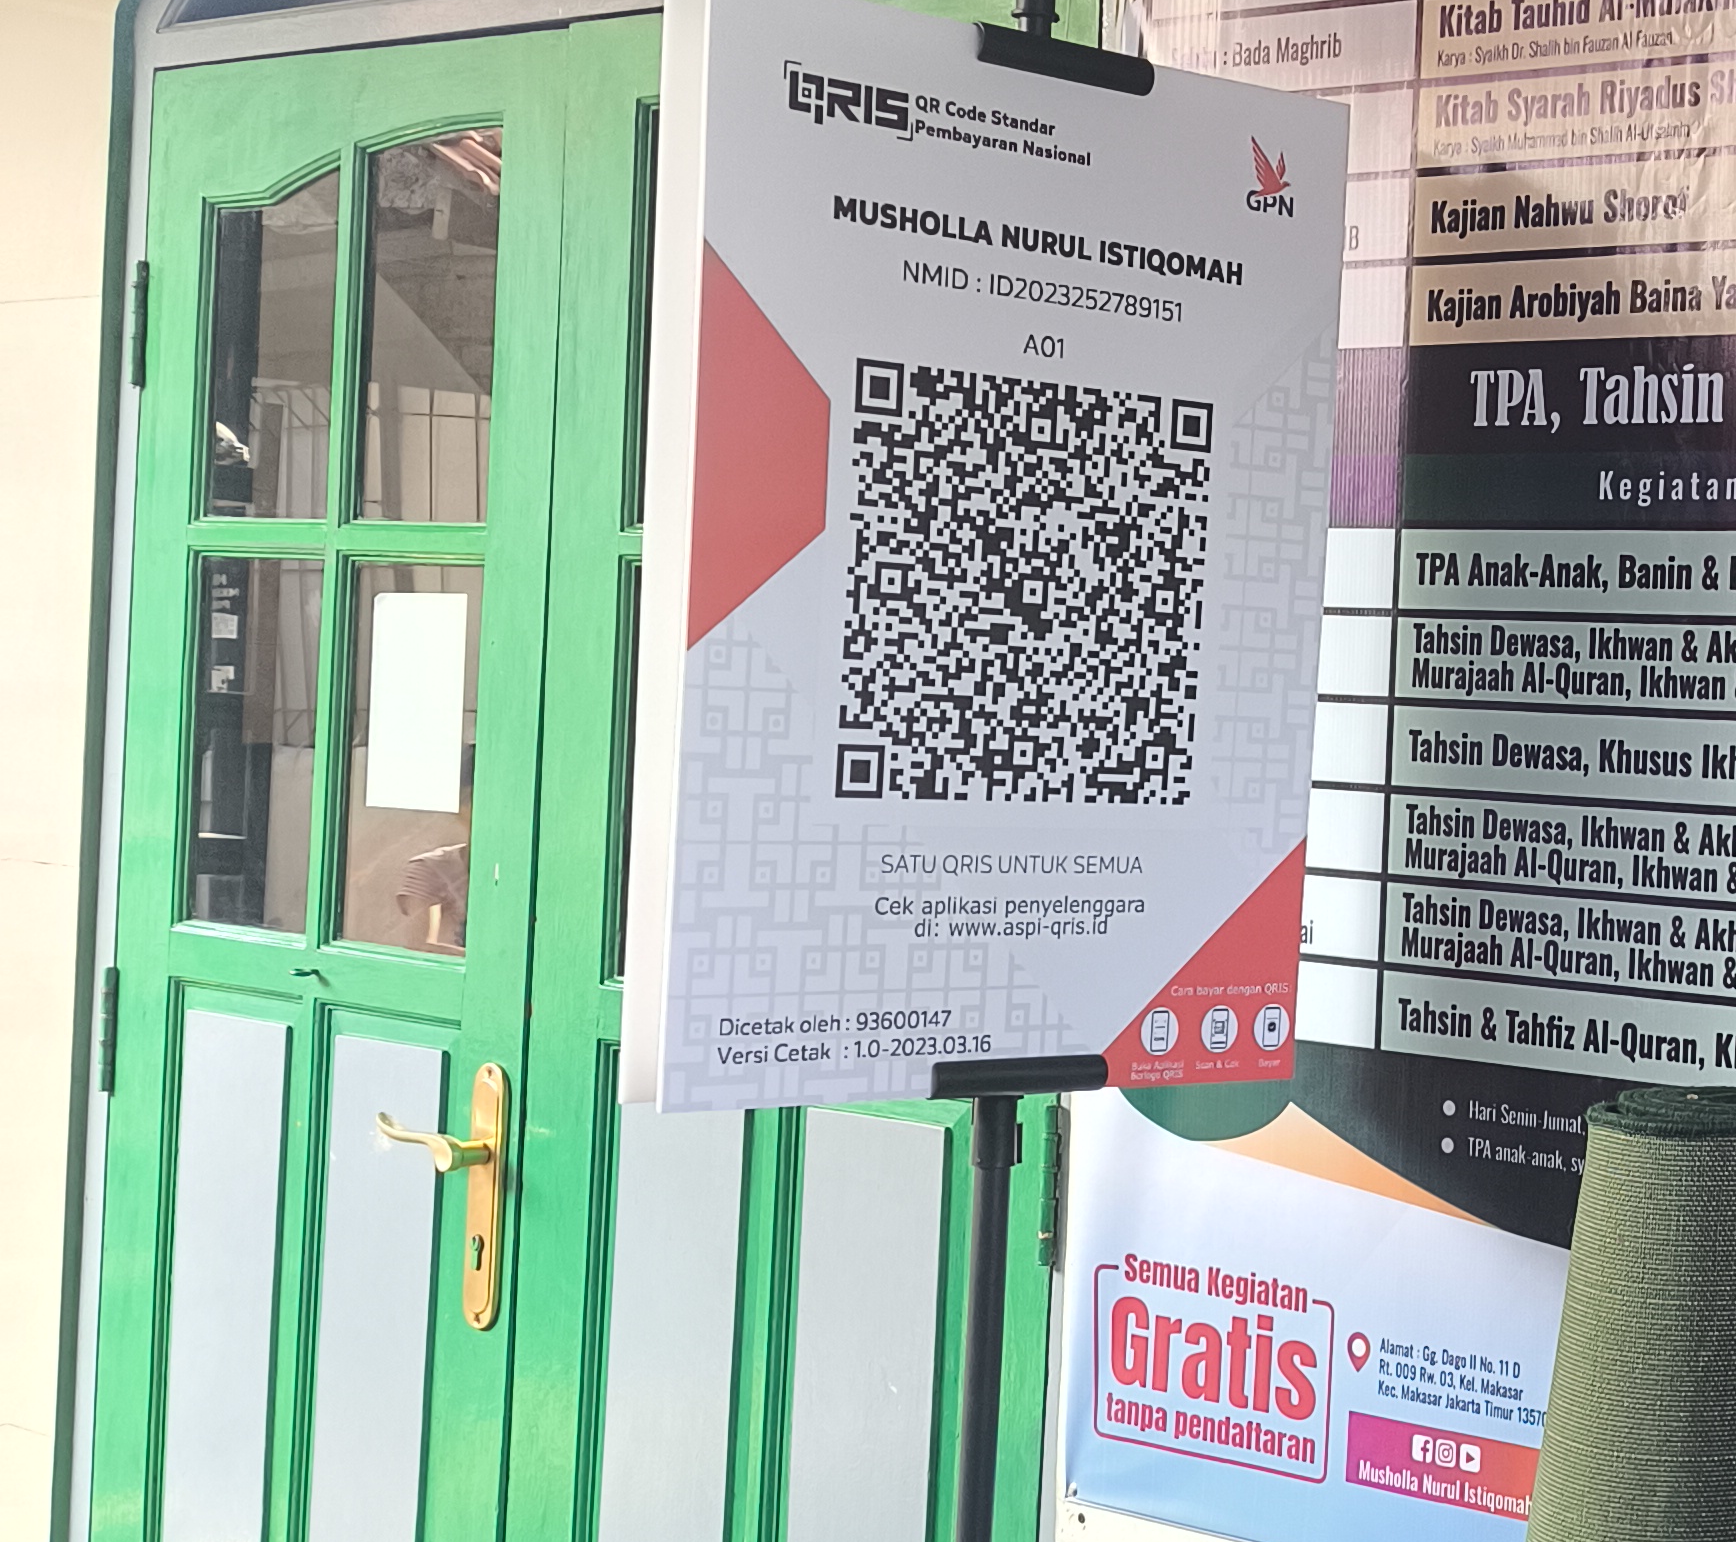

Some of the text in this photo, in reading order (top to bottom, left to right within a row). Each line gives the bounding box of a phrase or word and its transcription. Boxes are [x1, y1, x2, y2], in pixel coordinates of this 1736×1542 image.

[788, 71, 909, 131] QRIS
[915, 95, 1056, 137] QR Code Standar
[914, 118, 1091, 167] Pembayaran Nasional
[1246, 190, 1294, 218] GPN
[833, 195, 1243, 286] MUSHOLLA NURUL ISTIQOMAH
[903, 259, 1182, 323] NMID ID2023252789151
[1023, 333, 1064, 359] A01
[1470, 368, 1561, 434] TPA,
[1579, 363, 1724, 425] Tahsin
[1415, 552, 1460, 587] TPA
[1467, 552, 1609, 594] Anak-Anak,
[1618, 554, 1693, 591] Banin
[1701, 554, 1719, 591] &
[881, 854, 1143, 877] SATU QRIS UNTUK SEMUA
[875, 896, 1145, 920] Cek aplikasi penyelenggara
[914, 916, 1108, 939] di: www.aspi-qris.id
[719, 1009, 952, 1036] Dicetak oleh 93600147
[1398, 997, 1472, 1039] Tahsin
[1480, 1006, 1497, 1042] &
[1505, 1009, 1576, 1051] Tahfiz
[1582, 1018, 1705, 1071] Al-Quran,
[717, 1034, 992, 1065] Versi Cetak 1.0-2023.03.16
[1124, 1253, 1308, 1314] Semua Kegiatan
[1110, 1296, 1318, 1421] Gratis
[1378, 1358, 1524, 1402] Rt. 009 Rw. 03, Kel. Makasar
[1377, 1379, 1514, 1421] Kec. Makasar Jakarta Timur
[1106, 1392, 1316, 1465] tanpa pendaftaran
